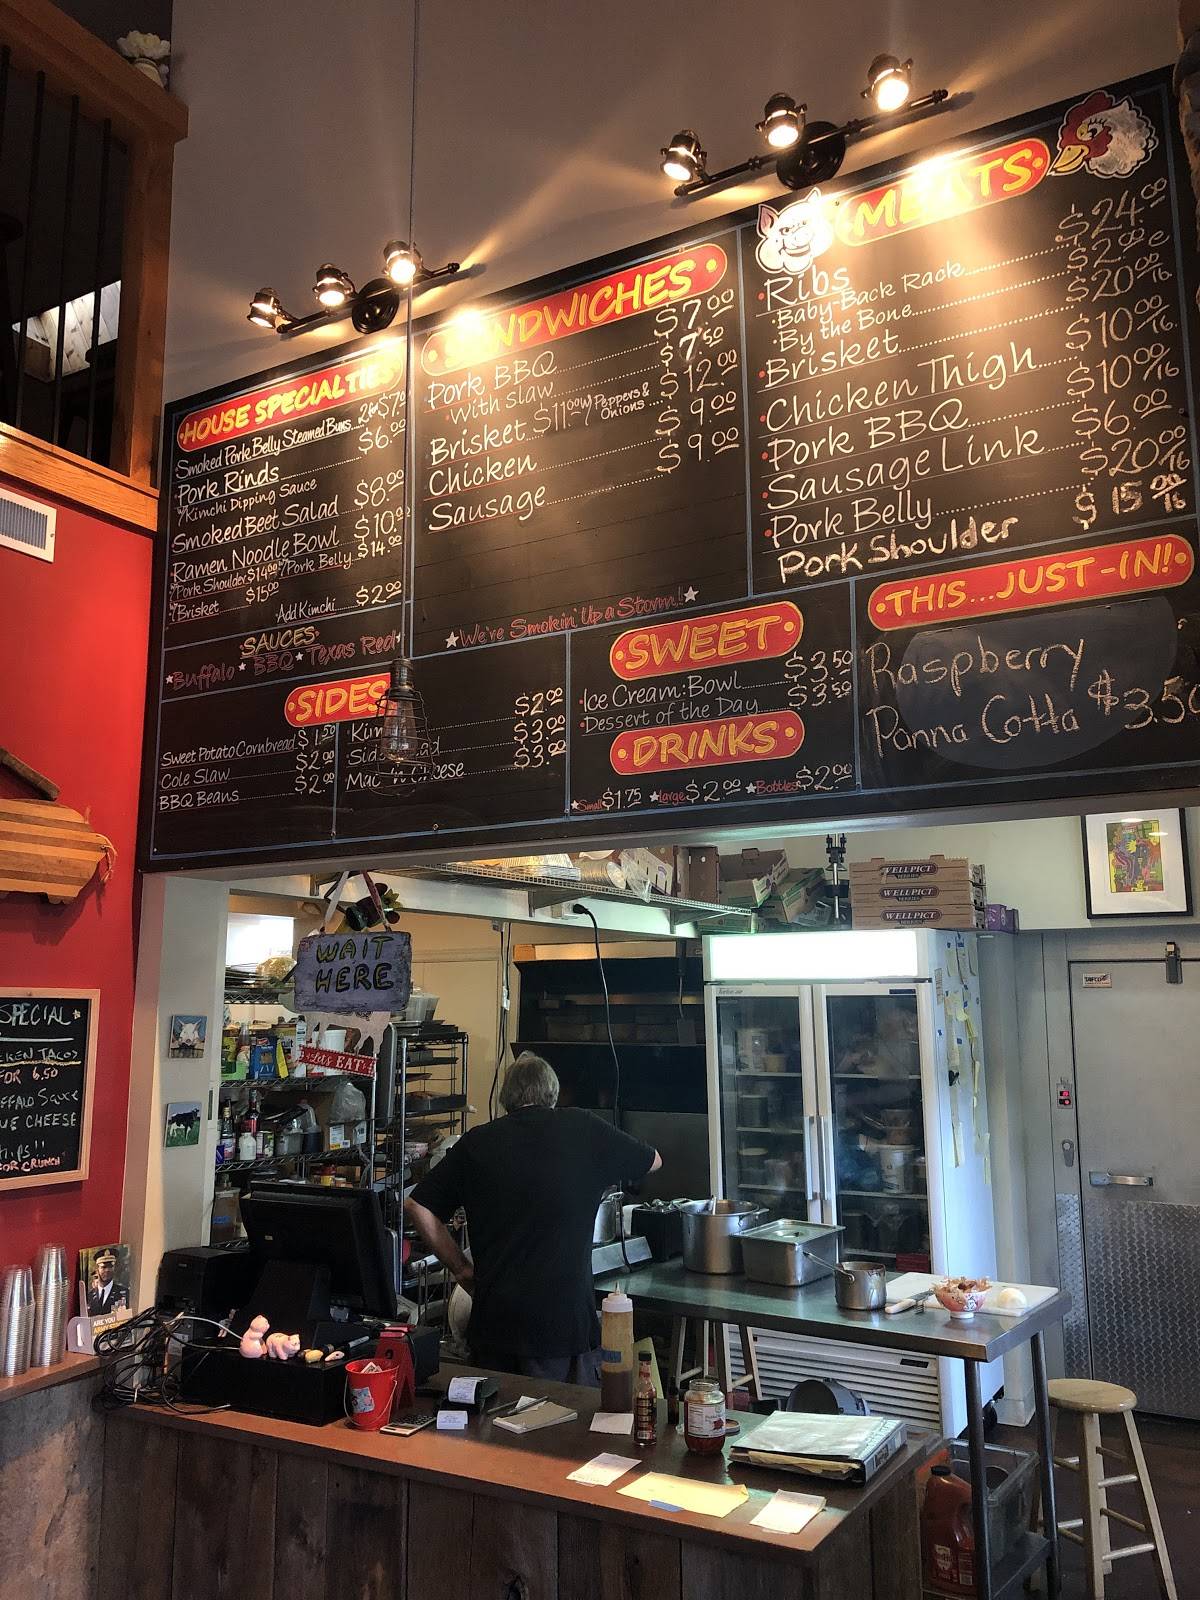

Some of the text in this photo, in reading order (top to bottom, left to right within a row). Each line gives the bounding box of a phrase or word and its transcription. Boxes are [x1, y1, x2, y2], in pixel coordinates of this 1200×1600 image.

[853, 148, 1033, 236] METS
[764, 264, 849, 311] Ribs
[902, 261, 965, 293] Rack
[444, 260, 697, 366] NDWICHES
[779, 330, 815, 356] By
[821, 316, 852, 340] the
[858, 304, 914, 330] Bone
[765, 328, 901, 388] Brisket
[428, 371, 485, 409] Pork
[495, 351, 557, 390] BBQ
[767, 376, 919, 432] Chicken
[918, 341, 1037, 390] Thigh
[183, 404, 250, 444] HOUSE
[601, 399, 645, 420] Onions
[176, 453, 222, 479] Smoked
[225, 444, 252, 465] Pork
[252, 436, 281, 459] Belly
[282, 424, 326, 447] Steamed
[378, 391, 405, 419] $7.0
[430, 419, 527, 467] Brisket
[768, 425, 855, 471] Pork
[866, 397, 969, 449] BBQ
[178, 481, 219, 507] Pork
[224, 462, 279, 493] Rinds
[429, 456, 538, 497] Chicken
[768, 449, 931, 510] Sausage
[941, 425, 1046, 473] Link
[230, 487, 277, 511] Dipping
[279, 478, 318, 498] Sauce
[429, 486, 546, 531] Sausage
[172, 520, 243, 554] Smoked
[245, 510, 280, 537] Beet
[282, 495, 339, 527] Salad
[771, 511, 844, 549] Pork
[852, 490, 932, 530] Belly
[172, 557, 228, 583] Ramen
[232, 539, 290, 568] Noodle
[293, 526, 340, 554] Bowl
[319, 551, 353, 570] Belly
[778, 540, 863, 583] Pork
[867, 516, 1019, 564] Shoulder
[204, 573, 247, 592] Shoulder
[277, 605, 297, 624] Add
[299, 597, 336, 619] Kimchi
[173, 630, 397, 690] Buffalo BBQ Texas Red
[243, 626, 315, 656] SAUCES
[625, 615, 782, 671] SWEET
[866, 635, 1085, 698] Raspberry
[295, 680, 388, 722] SIDES
[583, 688, 608, 713] Ice
[687, 671, 742, 698] Bowl
[584, 712, 650, 733] Dessert
[656, 704, 675, 726] of
[680, 701, 710, 721] the
[715, 696, 759, 717] Day
[866, 705, 970, 759] Panna
[981, 695, 1080, 743] Cotta
[161, 751, 197, 767] Sweet
[198, 745, 235, 763] Potato
[236, 734, 297, 758] Cornbread
[632, 720, 778, 767] DRINKS
[160, 793, 194, 811] BBQ
[197, 789, 239, 803] Beans
[161, 773, 190, 790] Cole
[195, 767, 231, 782] Slaw
[346, 771, 381, 791] Mac
[578, 798, 603, 812] Small
[755, 779, 800, 794] Bottles
[317, 936, 394, 963] WAIT
[316, 962, 394, 993] HERE
[336, 1055, 364, 1072] EAT
[26, 1112, 77, 1128] CHEESE
[21, 1156, 60, 1172] CRUNCH
